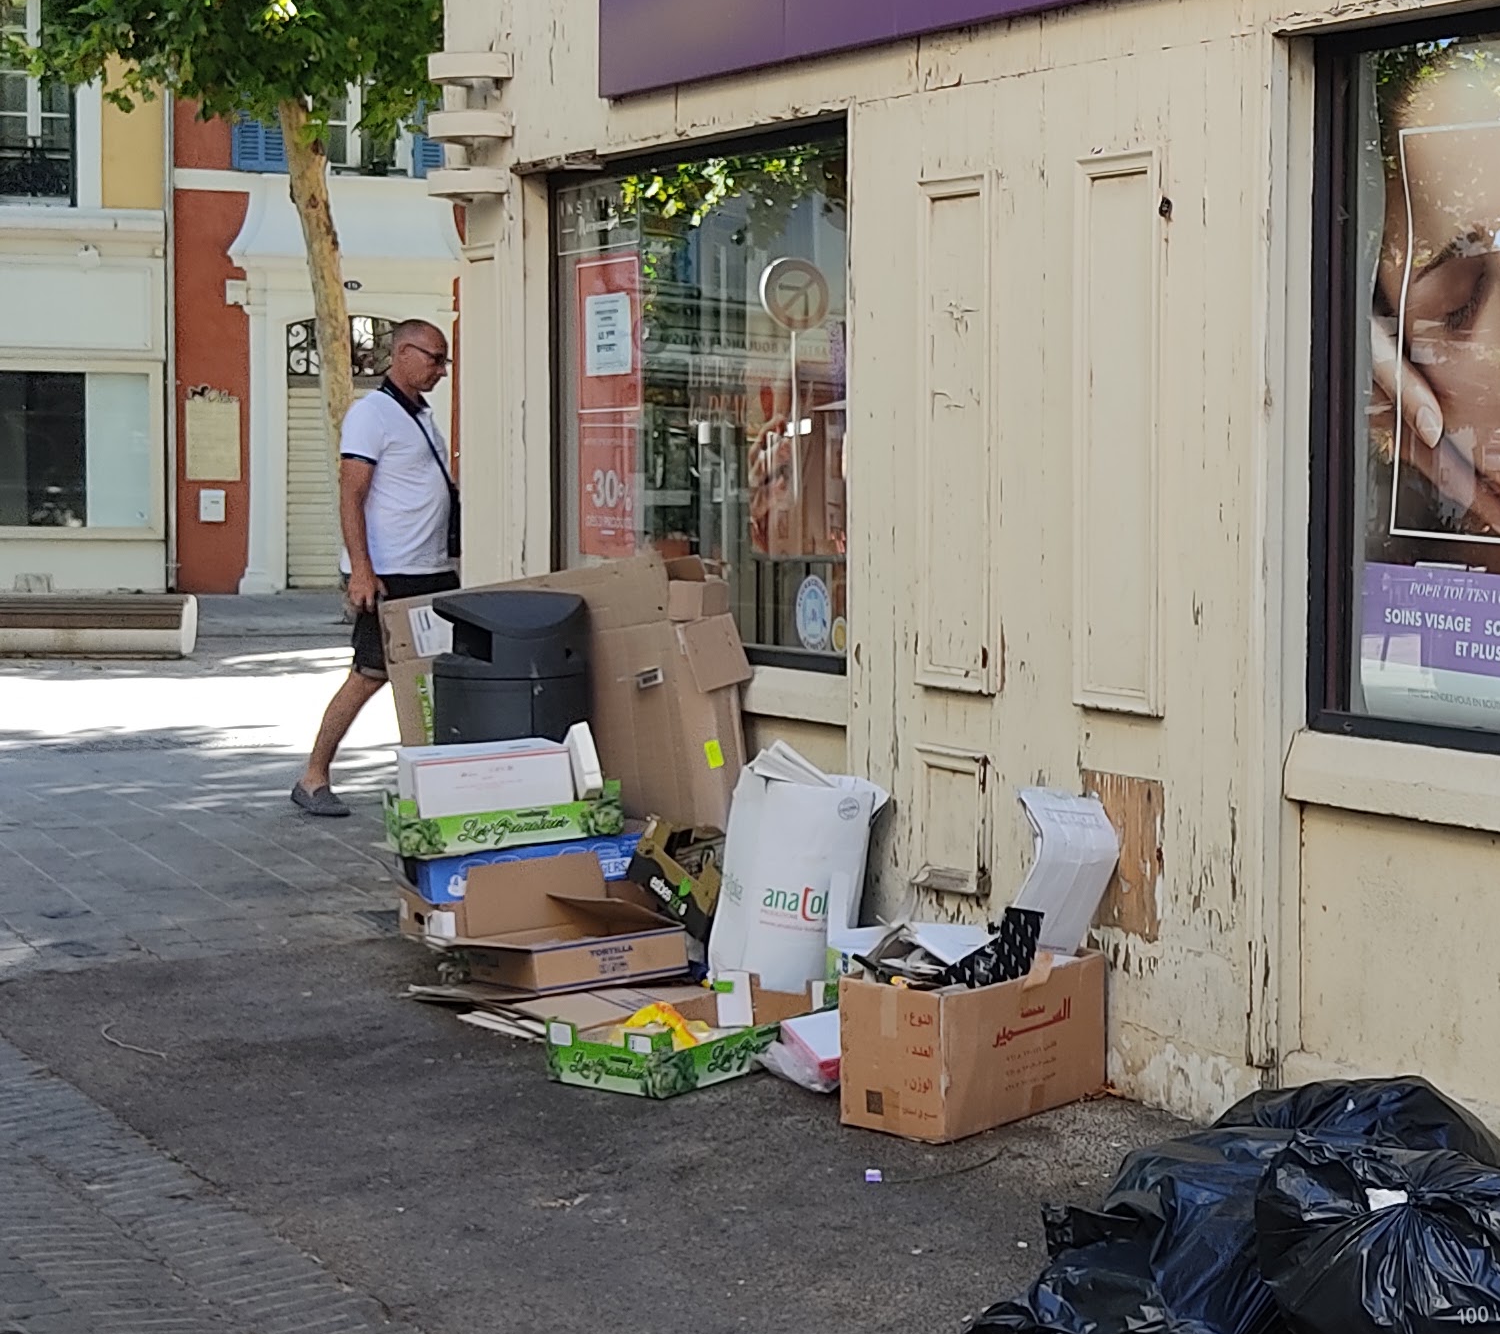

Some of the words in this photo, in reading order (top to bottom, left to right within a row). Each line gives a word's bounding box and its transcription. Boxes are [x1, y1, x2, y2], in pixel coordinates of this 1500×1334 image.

[560, 190, 627, 217] INSTITU
[1384, 608, 1422, 627] SOINS
[1424, 612, 1472, 633] VISAGE
[1455, 640, 1468, 658] ET
[1456, 1305, 1490, 1325] 100
